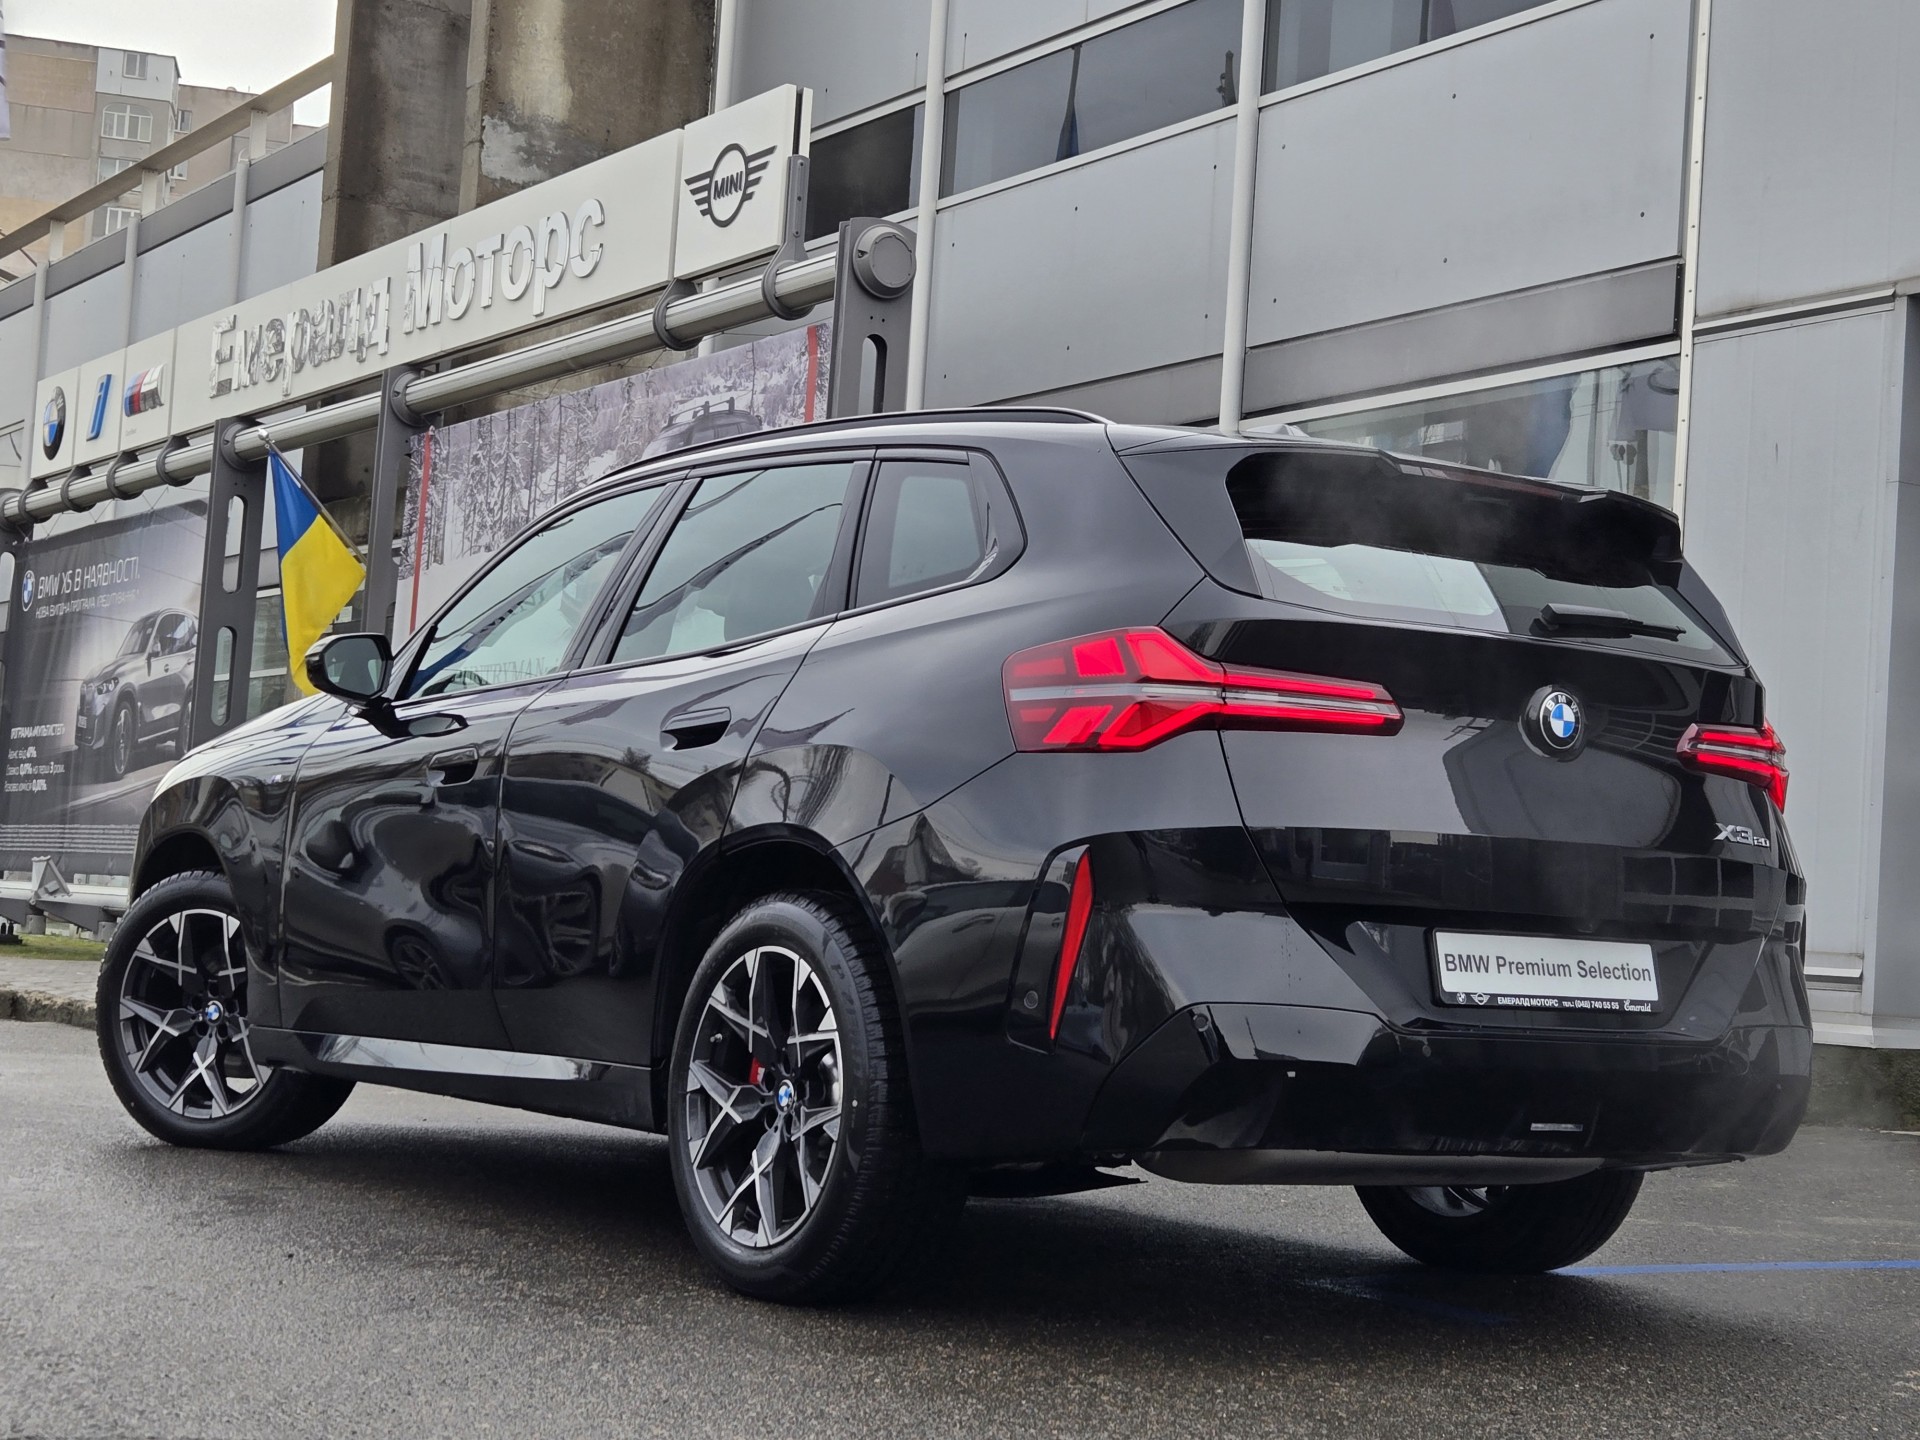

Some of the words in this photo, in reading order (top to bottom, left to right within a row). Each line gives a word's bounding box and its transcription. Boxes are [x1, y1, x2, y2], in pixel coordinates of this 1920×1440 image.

[713, 170, 744, 201] MINI
[403, 198, 606, 335] Моторс
[38, 573, 60, 599] BMW
[61, 570, 73, 594] X5
[1444, 953, 1490, 974] BMW
[1496, 955, 1572, 978] Premium
[1577, 959, 1652, 982] Selection
[1497, 997, 1530, 1008] ЕМЕРАЛД
[1530, 998, 1559, 1008] МОТОРС
[1591, 1001, 1602, 1009] 740
[1623, 999, 1652, 1012] Emerald
